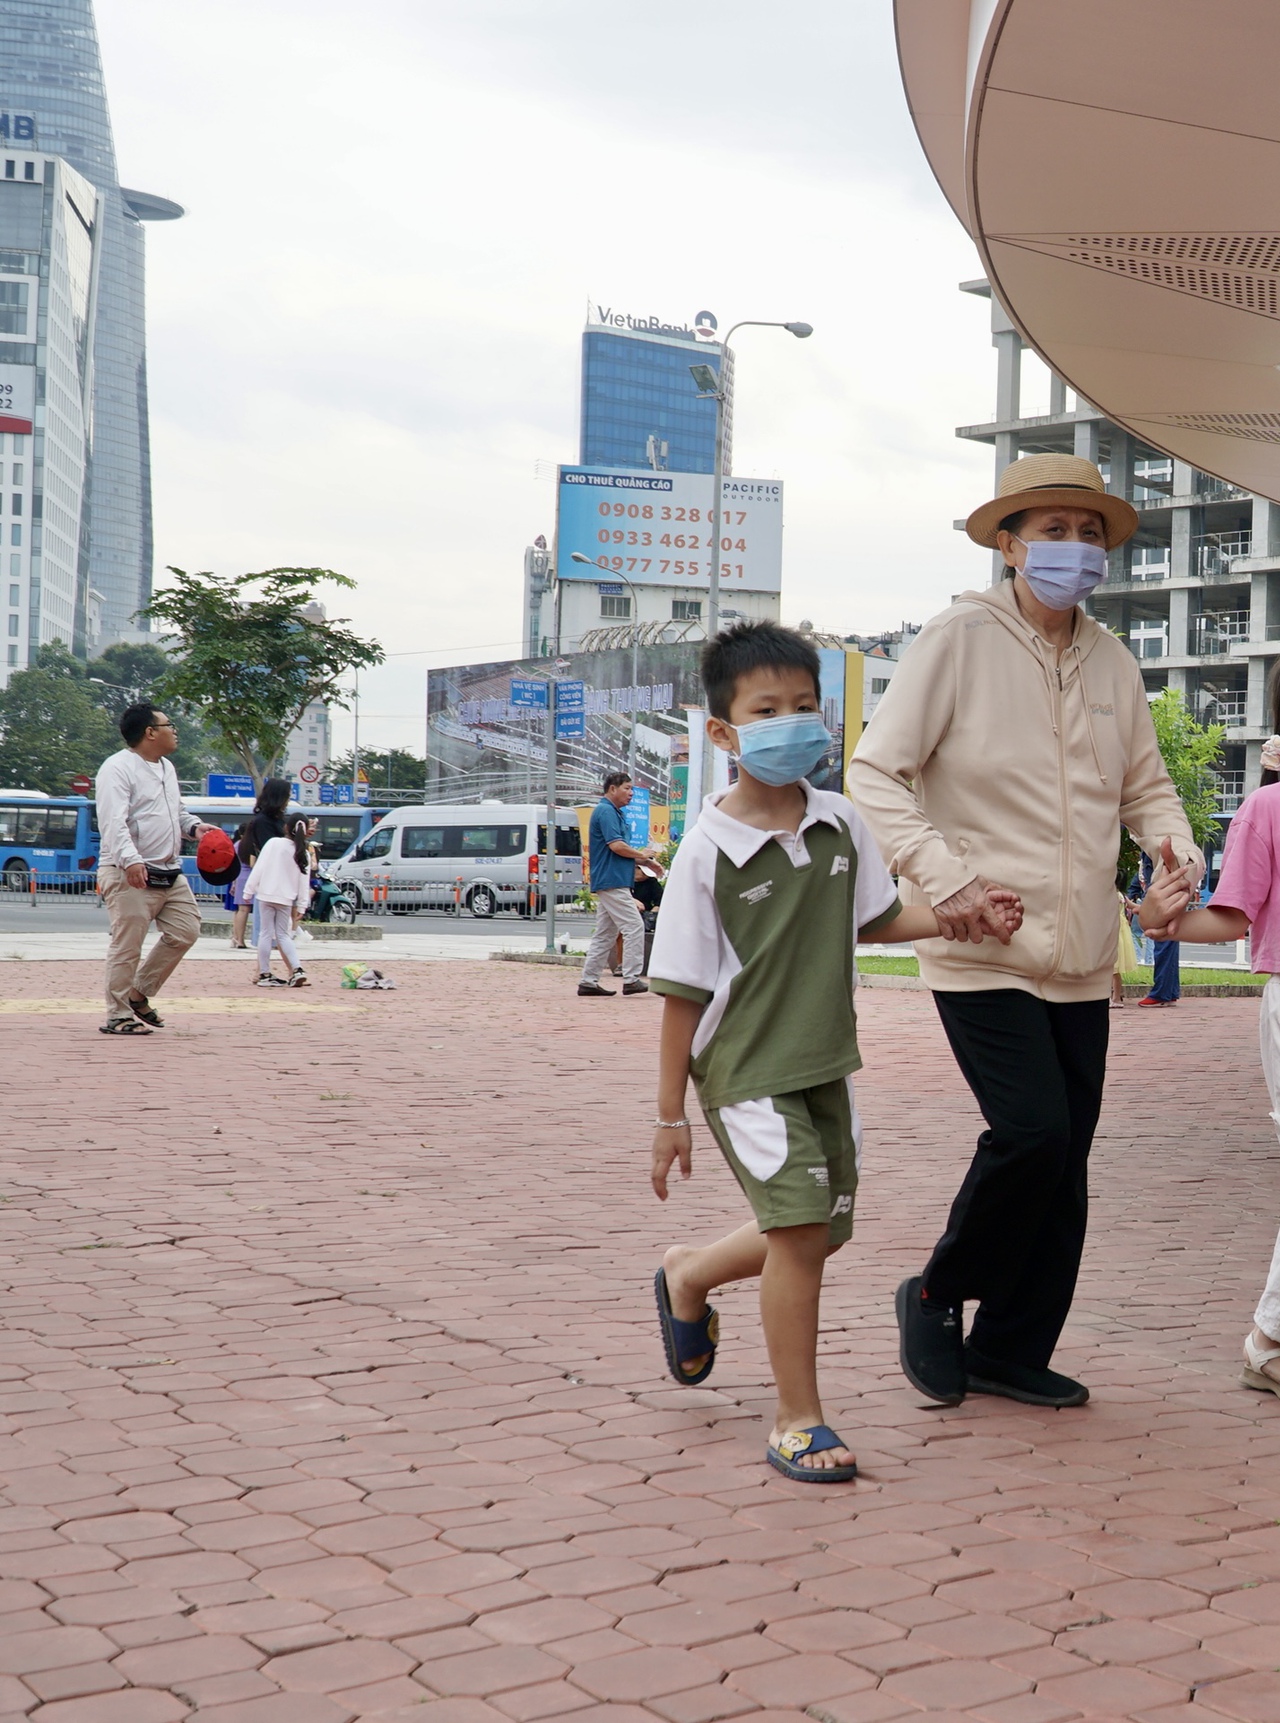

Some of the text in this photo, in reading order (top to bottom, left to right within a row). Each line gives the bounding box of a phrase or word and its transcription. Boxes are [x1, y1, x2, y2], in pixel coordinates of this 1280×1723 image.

[565, 474, 671, 490] CHO THUÊ QUẢNG CÁO
[723, 483, 779, 495] PACIFIC
[723, 494, 779, 503] OUTDOOR
[598, 502, 653, 519] 0908
[660, 506, 700, 523] 328
[597, 529, 653, 546] 0933
[660, 533, 699, 549] 462
[596, 555, 652, 572] 0977
[659, 559, 699, 575] 755
[512, 682, 524, 690] NHÀ
